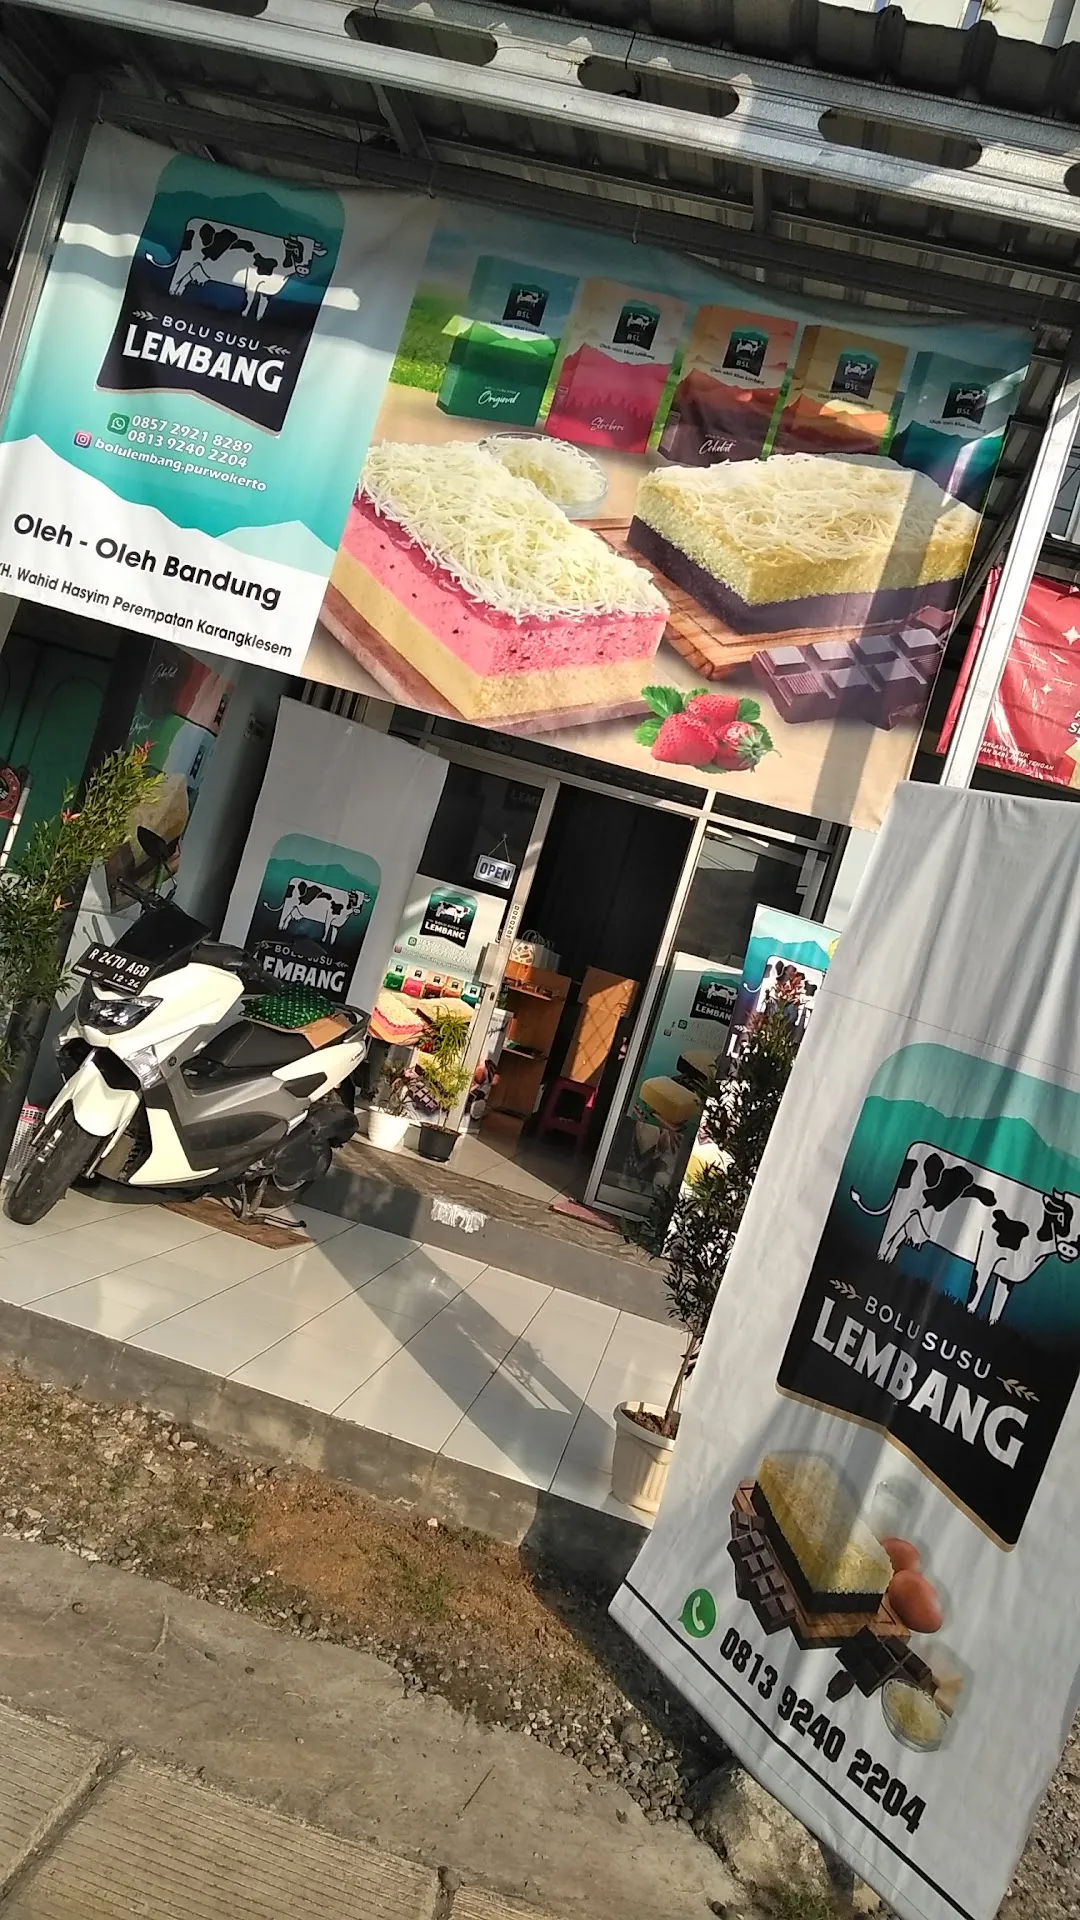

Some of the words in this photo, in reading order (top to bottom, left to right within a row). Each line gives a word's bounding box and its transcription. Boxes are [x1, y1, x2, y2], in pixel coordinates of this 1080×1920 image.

[162, 315, 210, 339] BOLU
[214, 330, 260, 351] SUSU
[516, 310, 530, 319] BSL
[122, 324, 284, 393] LEMBANG
[478, 390, 520, 408] Original
[128, 430, 162, 447] 0813
[167, 438, 205, 457] 9240
[208, 449, 248, 468] 2204
[132, 415, 169, 432] 0857
[171, 422, 208, 441] 2921
[212, 434, 253, 454] 8289
[95, 438, 267, 491] bolulembang.purwokerto
[14, 513, 73, 548] Oleh
[95, 537, 156, 572] Oleh
[162, 555, 282, 611] Bandung
[17, 566, 59, 590] Wahid
[61, 581, 110, 607] Hasyim
[113, 595, 194, 630] Perempatan
[196, 618, 293, 658] Karangklesem
[480, 862, 511, 881] OPEN
[424, 921, 465, 940] LEMBANG
[88, 948, 100, 960] R
[98, 951, 127, 969] 2470
[253, 951, 345, 992] EMBANG
[864, 1295, 920, 1339] BOLU
[921, 1332, 991, 1379] SUSU
[811, 1296, 1029, 1469] LEMBANG
[719, 1627, 778, 1700] 0813
[777, 1686, 846, 1763] 9240
[846, 1749, 927, 1834] 2204
